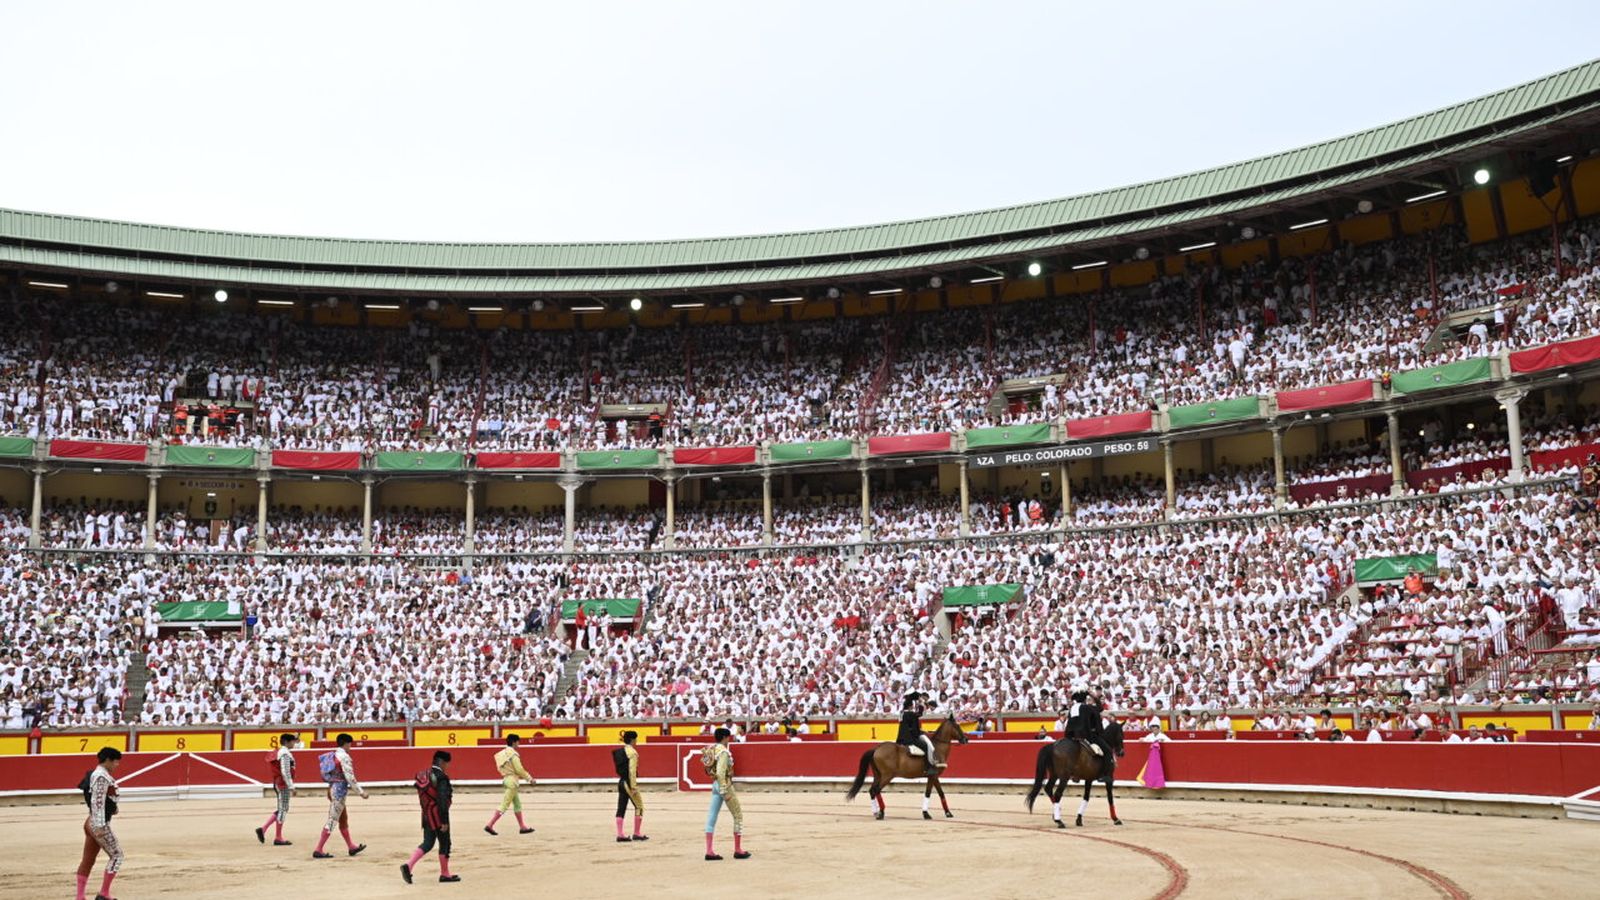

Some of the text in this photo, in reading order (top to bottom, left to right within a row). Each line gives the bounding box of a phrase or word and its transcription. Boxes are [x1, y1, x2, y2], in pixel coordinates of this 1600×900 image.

[1005, 453, 1034, 464] PELO:
[1035, 446, 1093, 461] COLORADO
[1104, 443, 1135, 454] PESO:
[448, 732, 456, 746] 8
[871, 727, 877, 740] 1
[80, 738, 89, 752] 7
[176, 737, 186, 750] 8
[269, 736, 279, 749] 8
